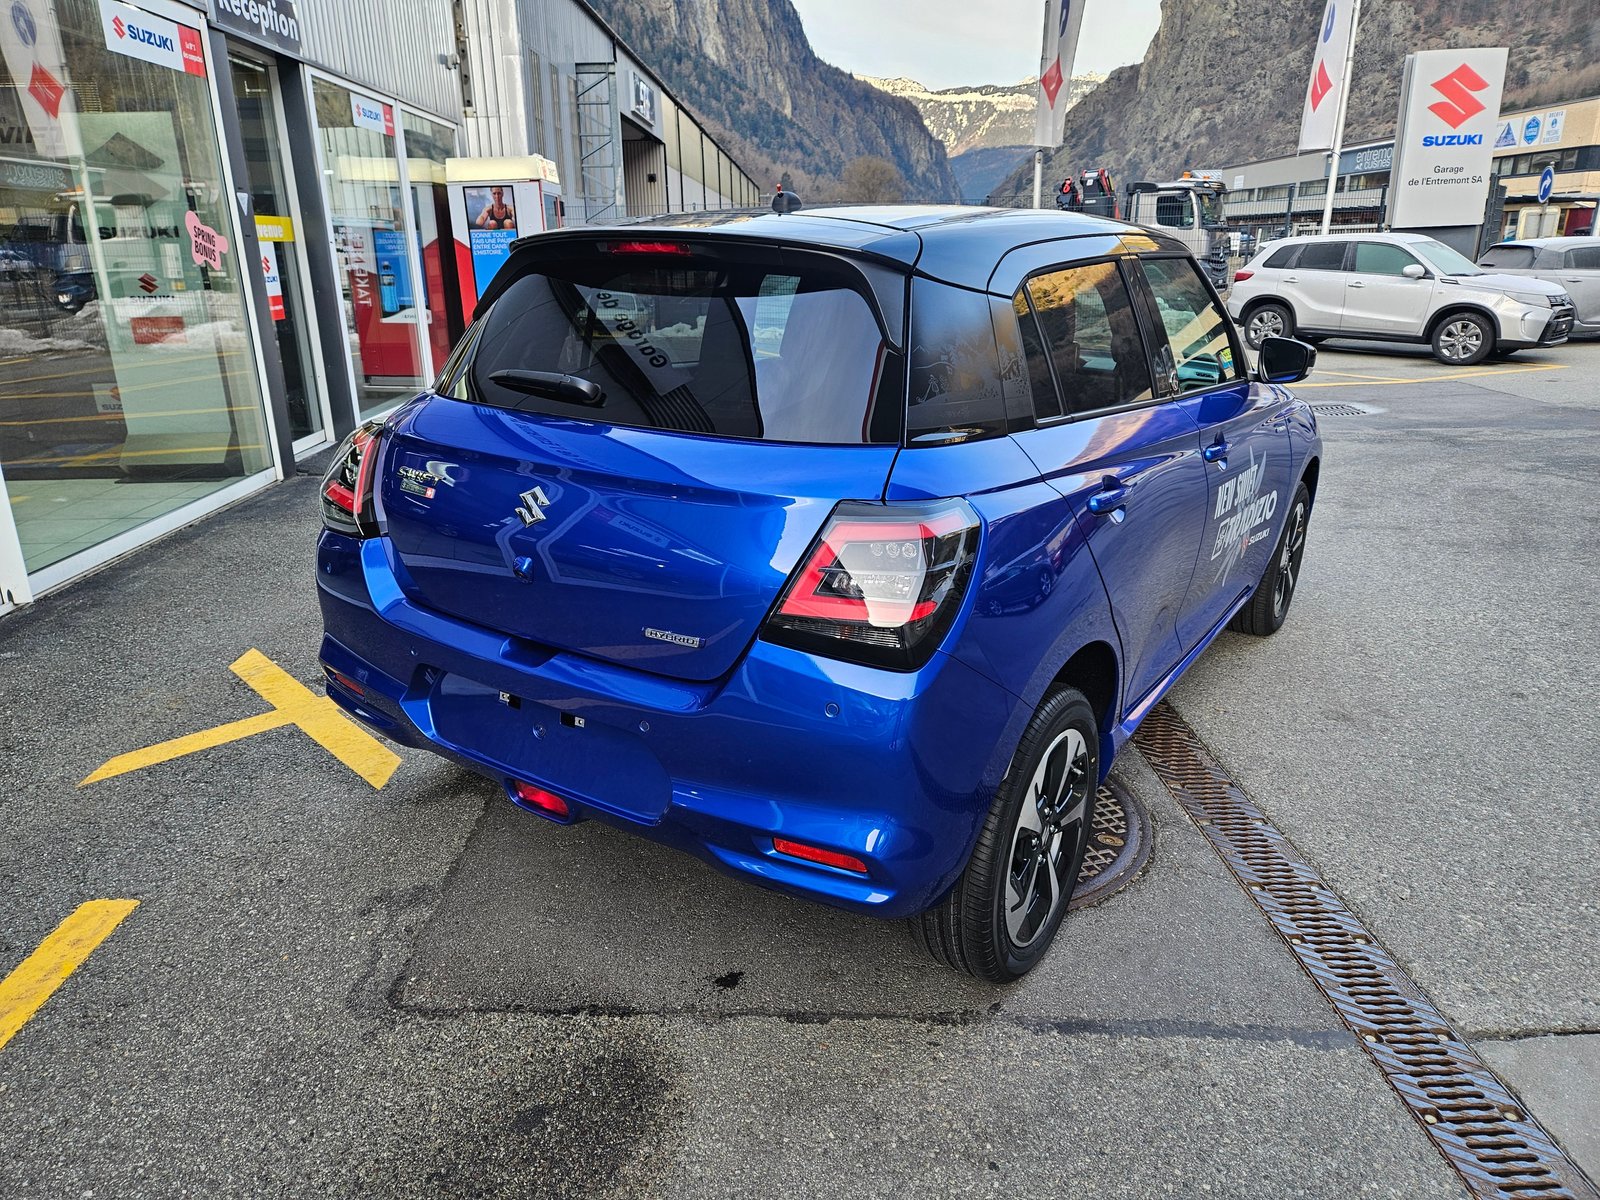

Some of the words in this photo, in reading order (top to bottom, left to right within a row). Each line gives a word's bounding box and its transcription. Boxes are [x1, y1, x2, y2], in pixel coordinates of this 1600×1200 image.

[127, 24, 174, 52] SUZUKI
[362, 108, 381, 121] SUZUKI
[1422, 134, 1483, 147] SUZUKI
[1433, 165, 1464, 175] Garage
[1408, 178, 1420, 187] de
[1421, 176, 1470, 186] l'Entremont
[1471, 175, 1483, 184] SA
[193, 225, 216, 248] SPRING
[194, 240, 216, 262] BONUS
[397, 466, 439, 486] SWIFT
[1213, 477, 1237, 520] NEW
[1235, 464, 1259, 507] SWIFT
[1249, 527, 1271, 546] SUZUKI
[648, 629, 696, 645] HYBRID
